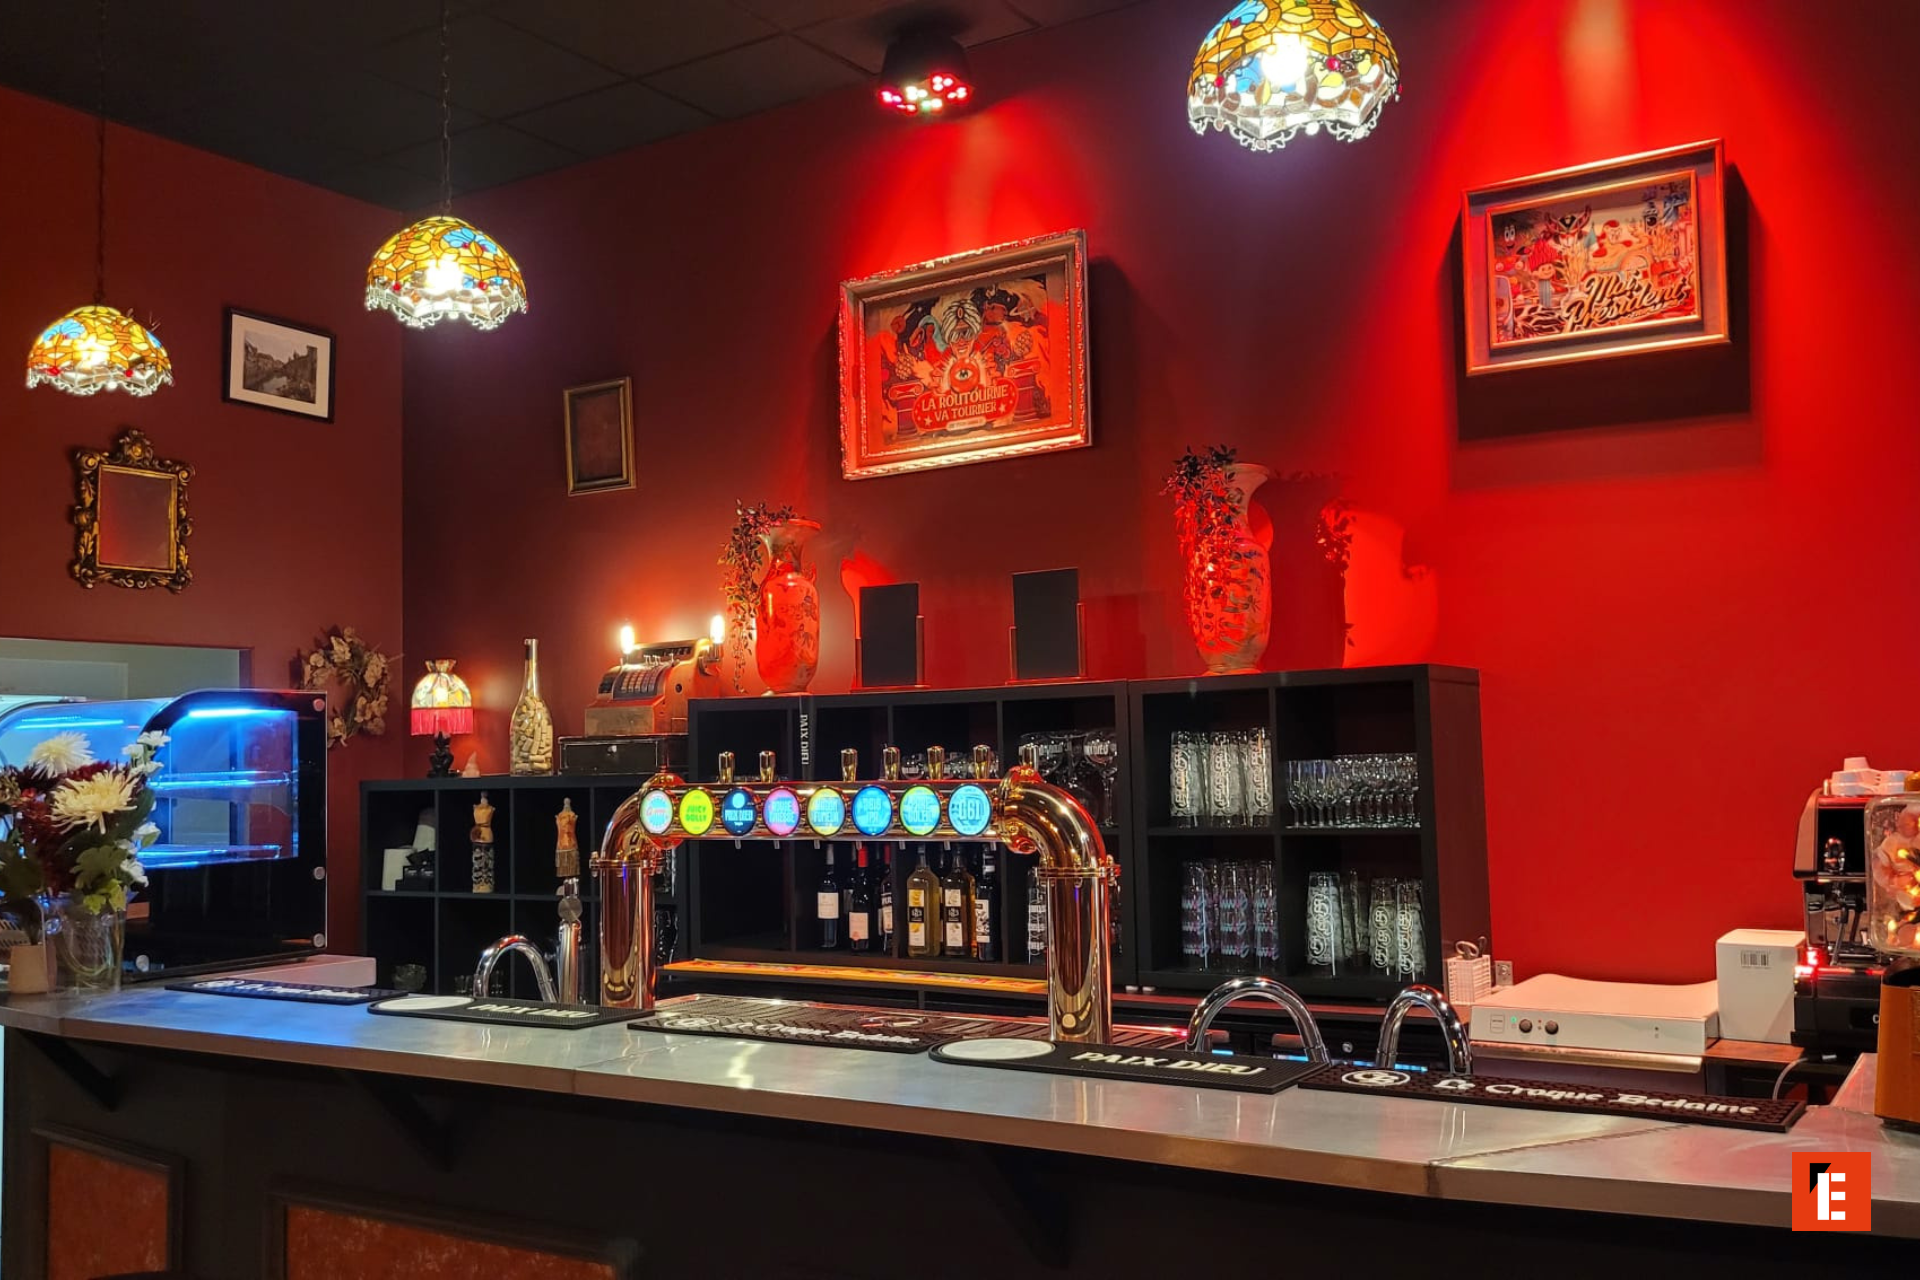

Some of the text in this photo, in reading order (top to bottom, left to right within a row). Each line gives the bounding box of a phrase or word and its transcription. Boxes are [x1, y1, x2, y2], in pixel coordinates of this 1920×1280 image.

[922, 385, 1009, 412] LA ROUTOURNE
[935, 402, 997, 422] VA TOURNER
[685, 814, 708, 822] DOLLY
[686, 805, 707, 814] JUICY
[1070, 1051, 1266, 1075] PAIX DIEU
[1433, 1079, 1760, 1115] Le Croque Bedaine
